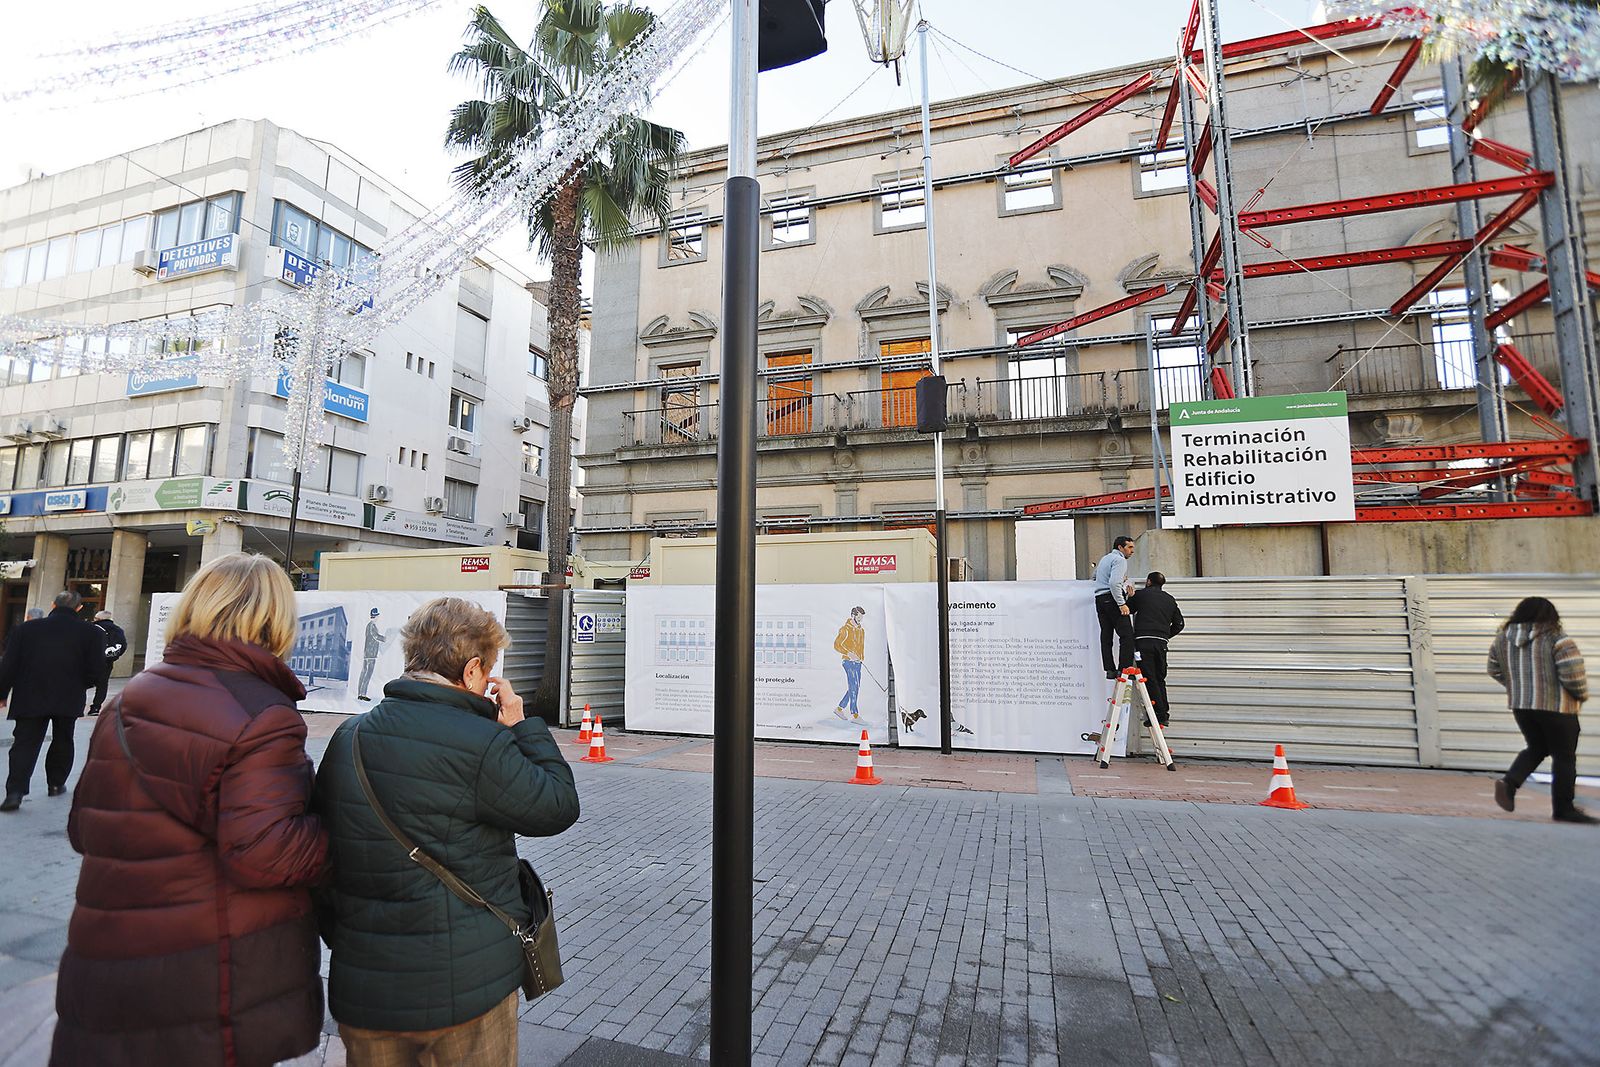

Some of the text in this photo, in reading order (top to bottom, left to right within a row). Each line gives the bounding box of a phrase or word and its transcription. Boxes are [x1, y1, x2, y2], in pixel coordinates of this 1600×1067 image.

[162, 236, 230, 262] DETECTIVES
[174, 252, 217, 270] PRIVADOS
[348, 395, 365, 403] BANCO
[1182, 426, 1306, 448] Terminación
[1184, 446, 1327, 467] Rehabilitación
[1185, 470, 1255, 487] Edificio
[306, 499, 321, 507] Planes
[1185, 487, 1337, 507] Administrativo
[462, 558, 489, 566] REMSA
[856, 556, 895, 566] REMSA
[655, 672, 690, 680] Localización
